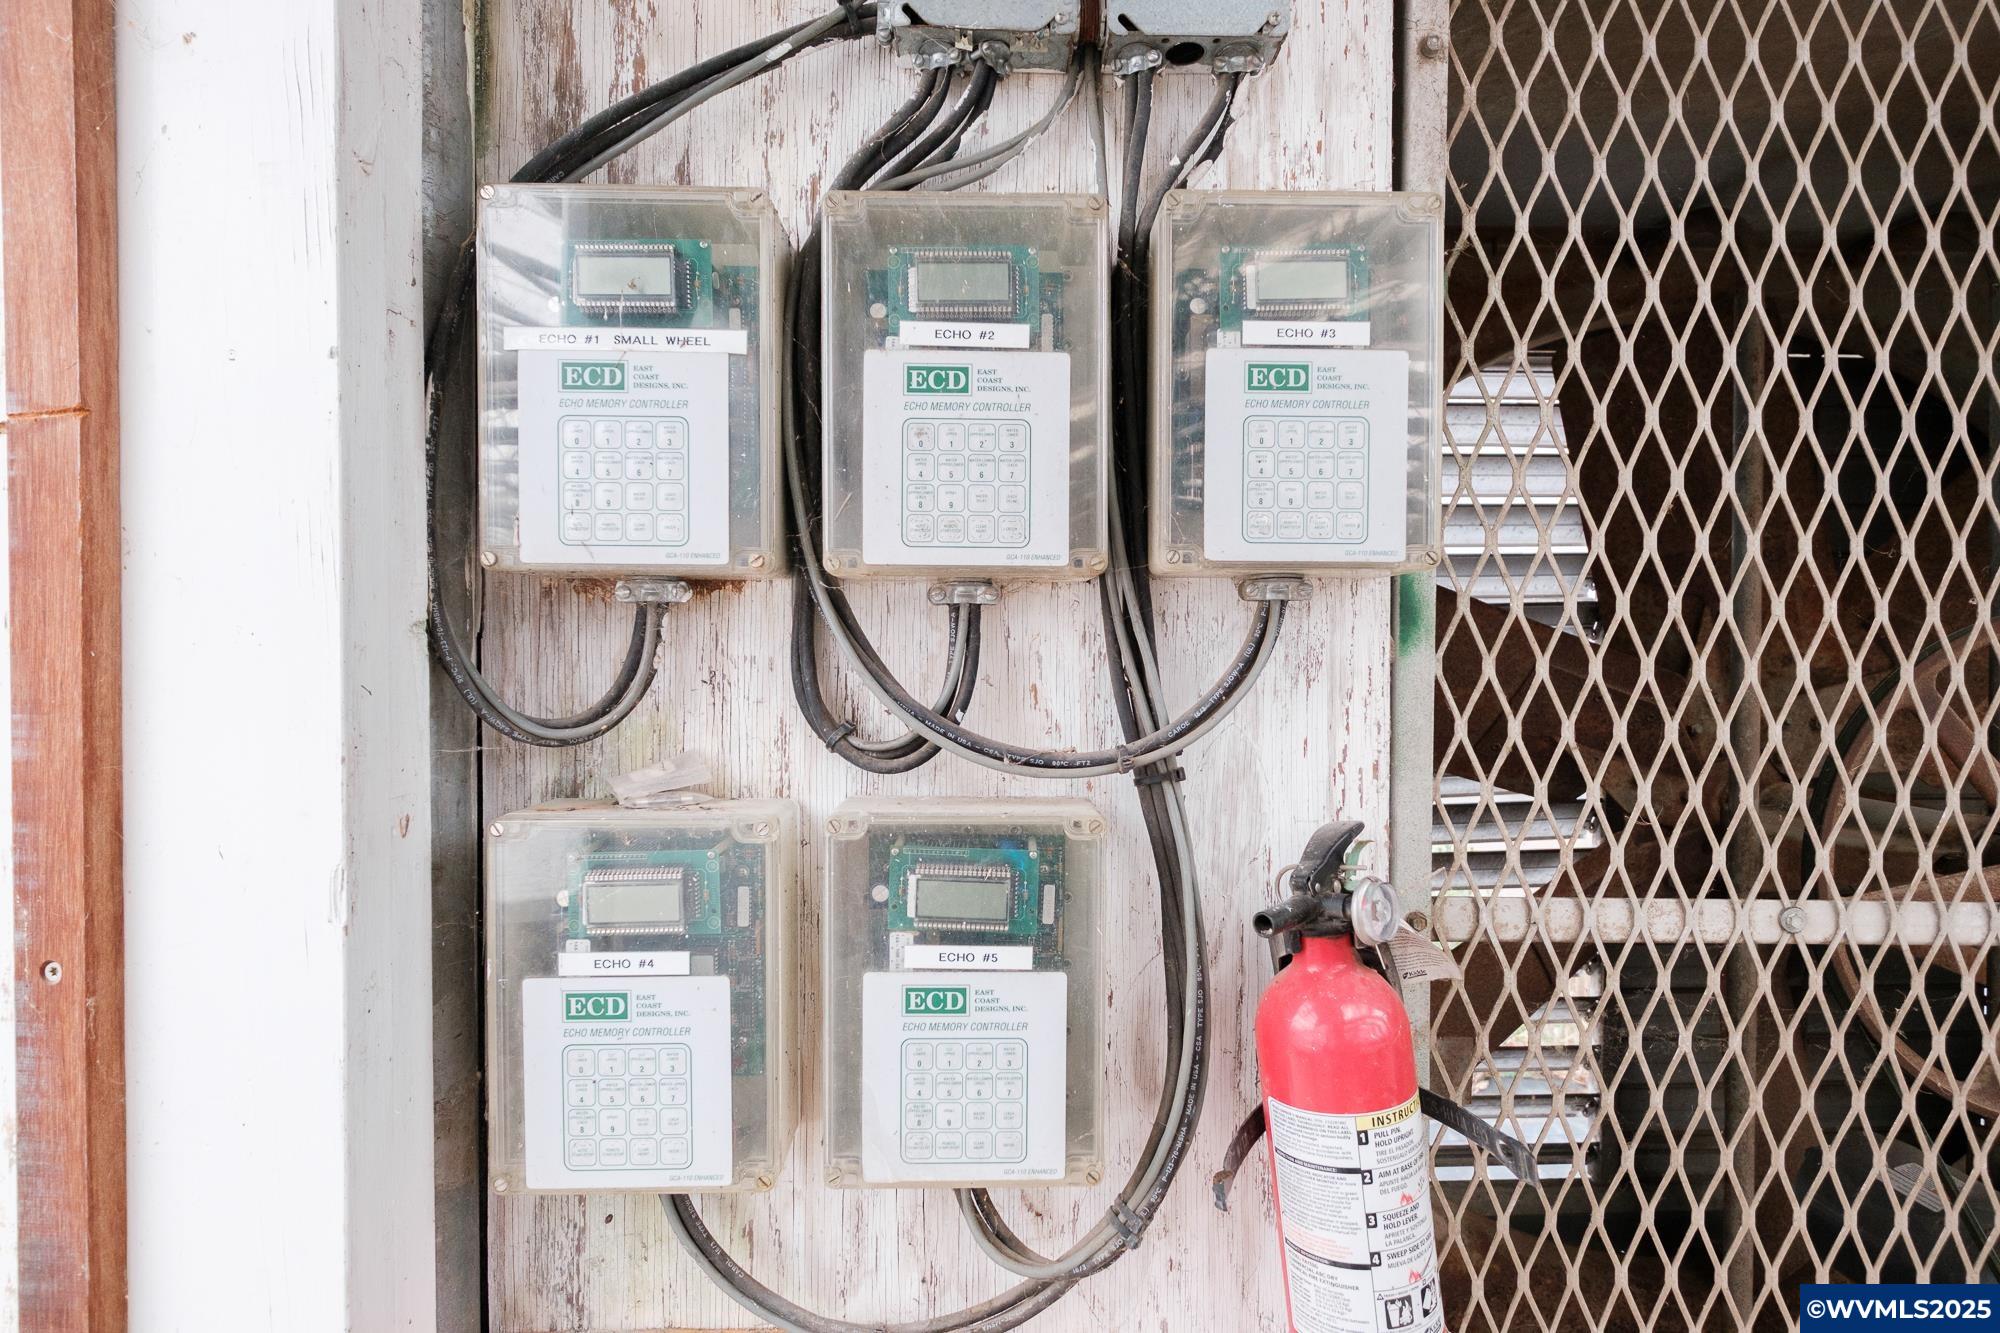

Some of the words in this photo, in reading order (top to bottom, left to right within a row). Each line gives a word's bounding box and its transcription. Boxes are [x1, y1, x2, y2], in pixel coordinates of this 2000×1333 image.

[935, 330, 971, 339] ECHO
[980, 331, 994, 340] #2
[1277, 328, 1313, 338] ECHO
[1321, 329, 1335, 338] #3
[540, 334, 576, 344] ECHO
[585, 335, 598, 344] #1
[614, 335, 657, 344] SMALL
[666, 336, 710, 348] WHEEL
[564, 366, 622, 387] ECD
[910, 370, 965, 389] ECD
[1250, 368, 1306, 386] ECD
[559, 398, 584, 408] ECHO
[586, 399, 627, 408] MEMORY
[630, 399, 688, 408] CONTROLLER
[904, 402, 928, 410] ECHO
[930, 402, 970, 411] MEMORY
[973, 402, 1031, 412] CONTROLLER
[1245, 399, 1268, 408] ECHO
[1271, 400, 1310, 408] MEMORY
[1313, 400, 1370, 409] CONTROLLER
[1168, 720, 1190, 737] CAROL
[1209, 688, 1224, 704] TYPE
[1224, 662, 1244, 688] SJOW-A
[1244, 643, 1256, 657] (UL)
[924, 719, 945, 734] MADE
[947, 731, 955, 739] IN
[957, 736, 972, 747] USA
[594, 959, 630, 968] ECHO
[939, 953, 975, 962] ECHO
[983, 954, 998, 962] #5
[568, 997, 625, 1016] ECD
[907, 992, 963, 1010] ECD
[563, 1028, 587, 1038] ECHO
[590, 1028, 630, 1037] MEMORY
[632, 1027, 691, 1036] CONTROLLER
[902, 1022, 926, 1031] ECHO
[929, 1022, 968, 1031] MEMORY
[970, 1022, 1028, 1031] CONTROLLER
[1190, 1082, 1197, 1092] IN
[1186, 1092, 1195, 1116] MADE
[1360, 1132, 1366, 1143] 1
[1374, 1130, 1389, 1139] PULL
[1375, 1139, 1392, 1148] HOLD
[1394, 1128, 1414, 1143] UPRIGHT
[1378, 1170, 1392, 1178] AIM
[1400, 1162, 1413, 1173] BASE
[1364, 1172, 1371, 1182] 2
[1382, 1208, 1408, 1221] SQUEEZE
[1410, 1202, 1419, 1212] AND
[1368, 1215, 1376, 1226] 3
[1384, 1220, 1401, 1230] HOLD
[1402, 1213, 1418, 1225] LEVER
[1387, 1249, 1408, 1260] SWEEP
[1409, 1244, 1420, 1254] SIDE
[1372, 1254, 1380, 1265] 4
[725, 1258, 744, 1278] CAROL
